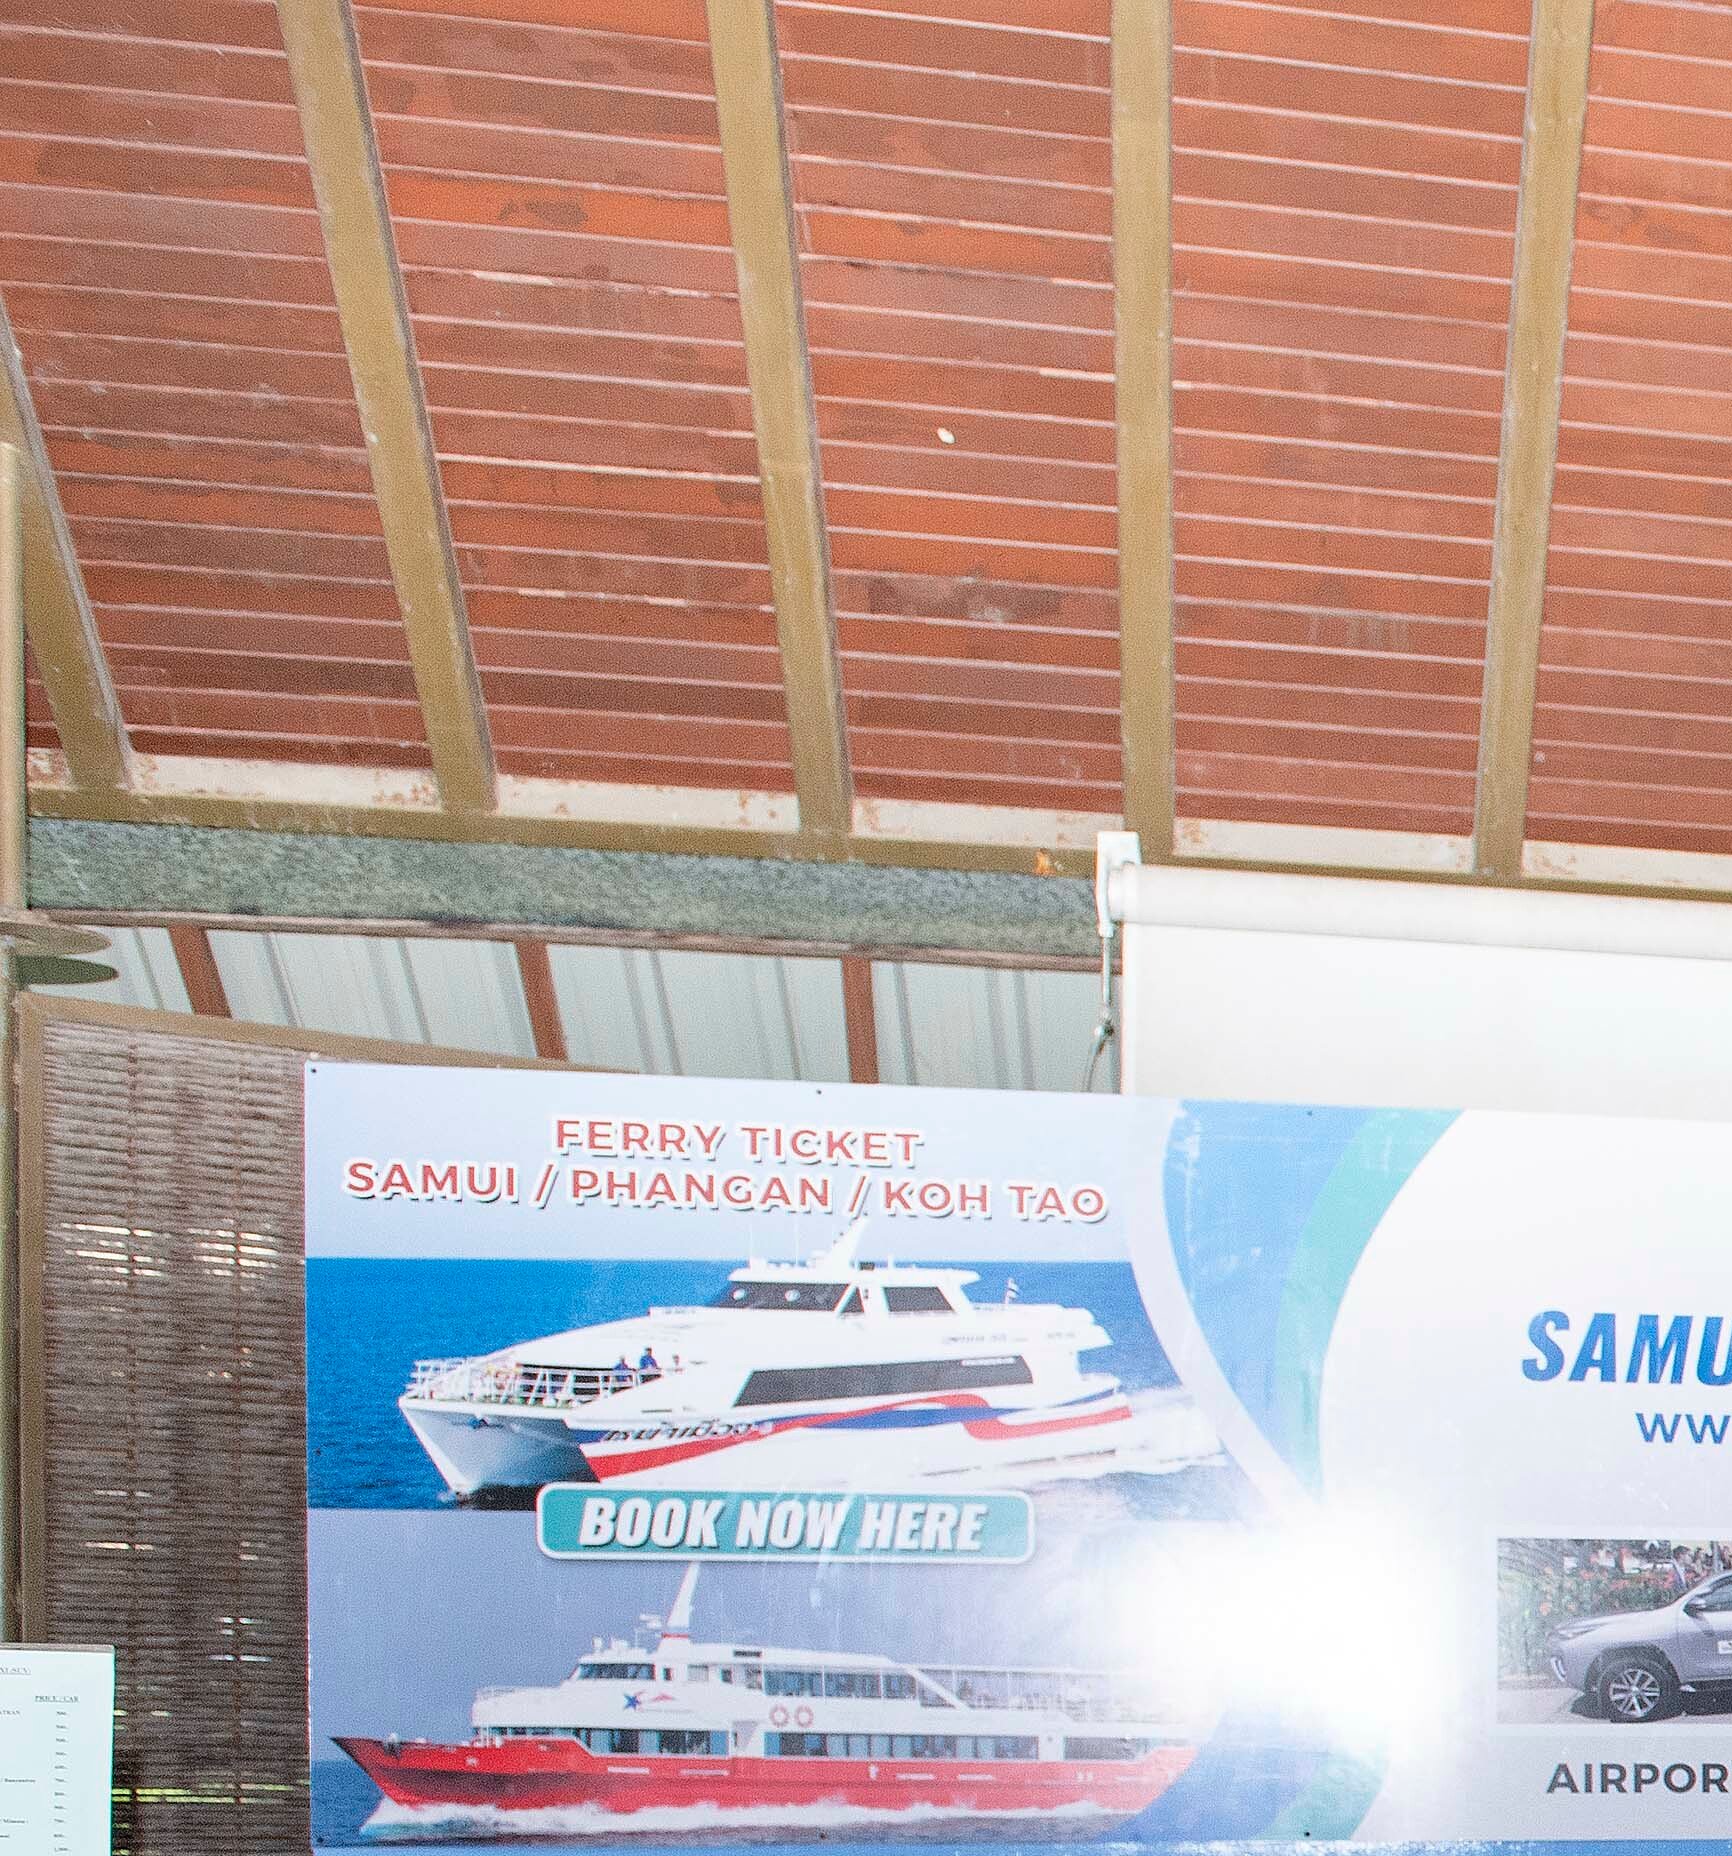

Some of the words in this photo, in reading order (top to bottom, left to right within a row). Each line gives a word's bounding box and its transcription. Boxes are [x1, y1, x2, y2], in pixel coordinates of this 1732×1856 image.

[554, 1118, 723, 1156] FERRY
[740, 1126, 924, 1162] TICKET
[346, 1161, 516, 1198] SAMUI
[571, 1169, 830, 1207] PHANGAN
[883, 1180, 989, 1214] KOH
[1007, 1185, 1104, 1217] TAO
[580, 1495, 726, 1549] BOOK
[737, 1500, 847, 1550] NOW
[856, 1503, 987, 1552] HERE
